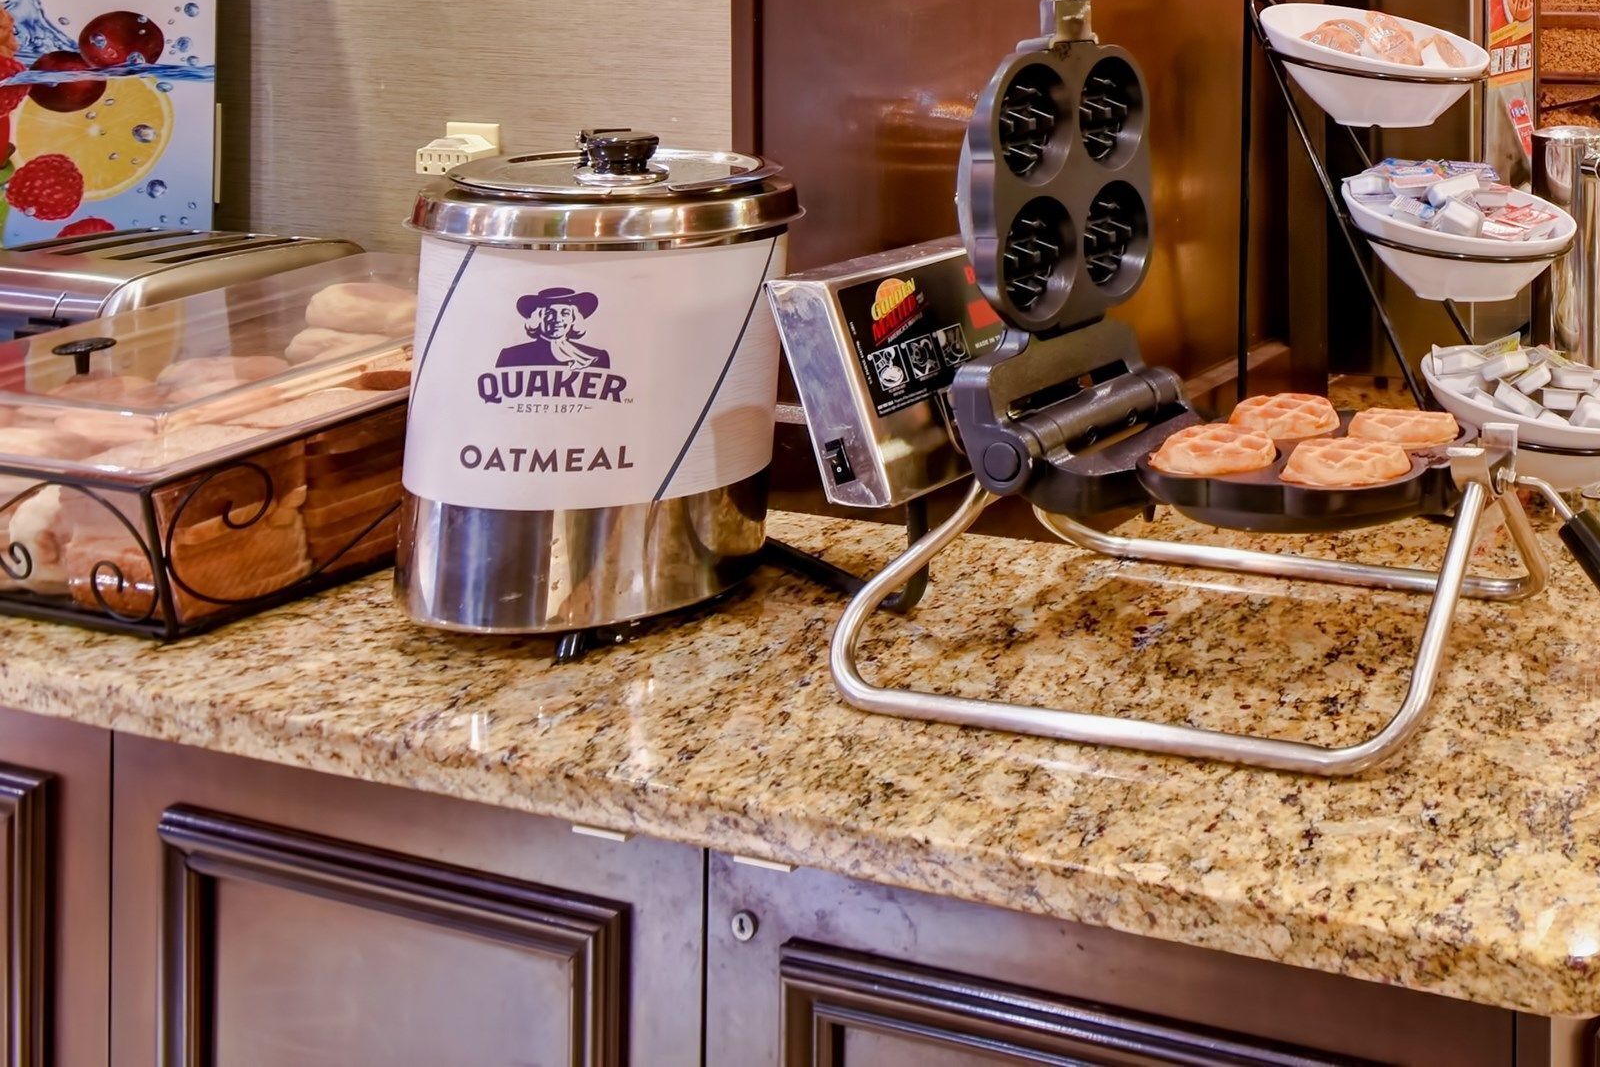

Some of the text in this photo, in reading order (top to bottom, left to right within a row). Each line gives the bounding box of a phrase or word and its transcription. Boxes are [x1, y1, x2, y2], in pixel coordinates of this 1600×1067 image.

[477, 370, 628, 404] QUAKER
[554, 403, 583, 414] 1877
[459, 444, 634, 473] OATMEAL
